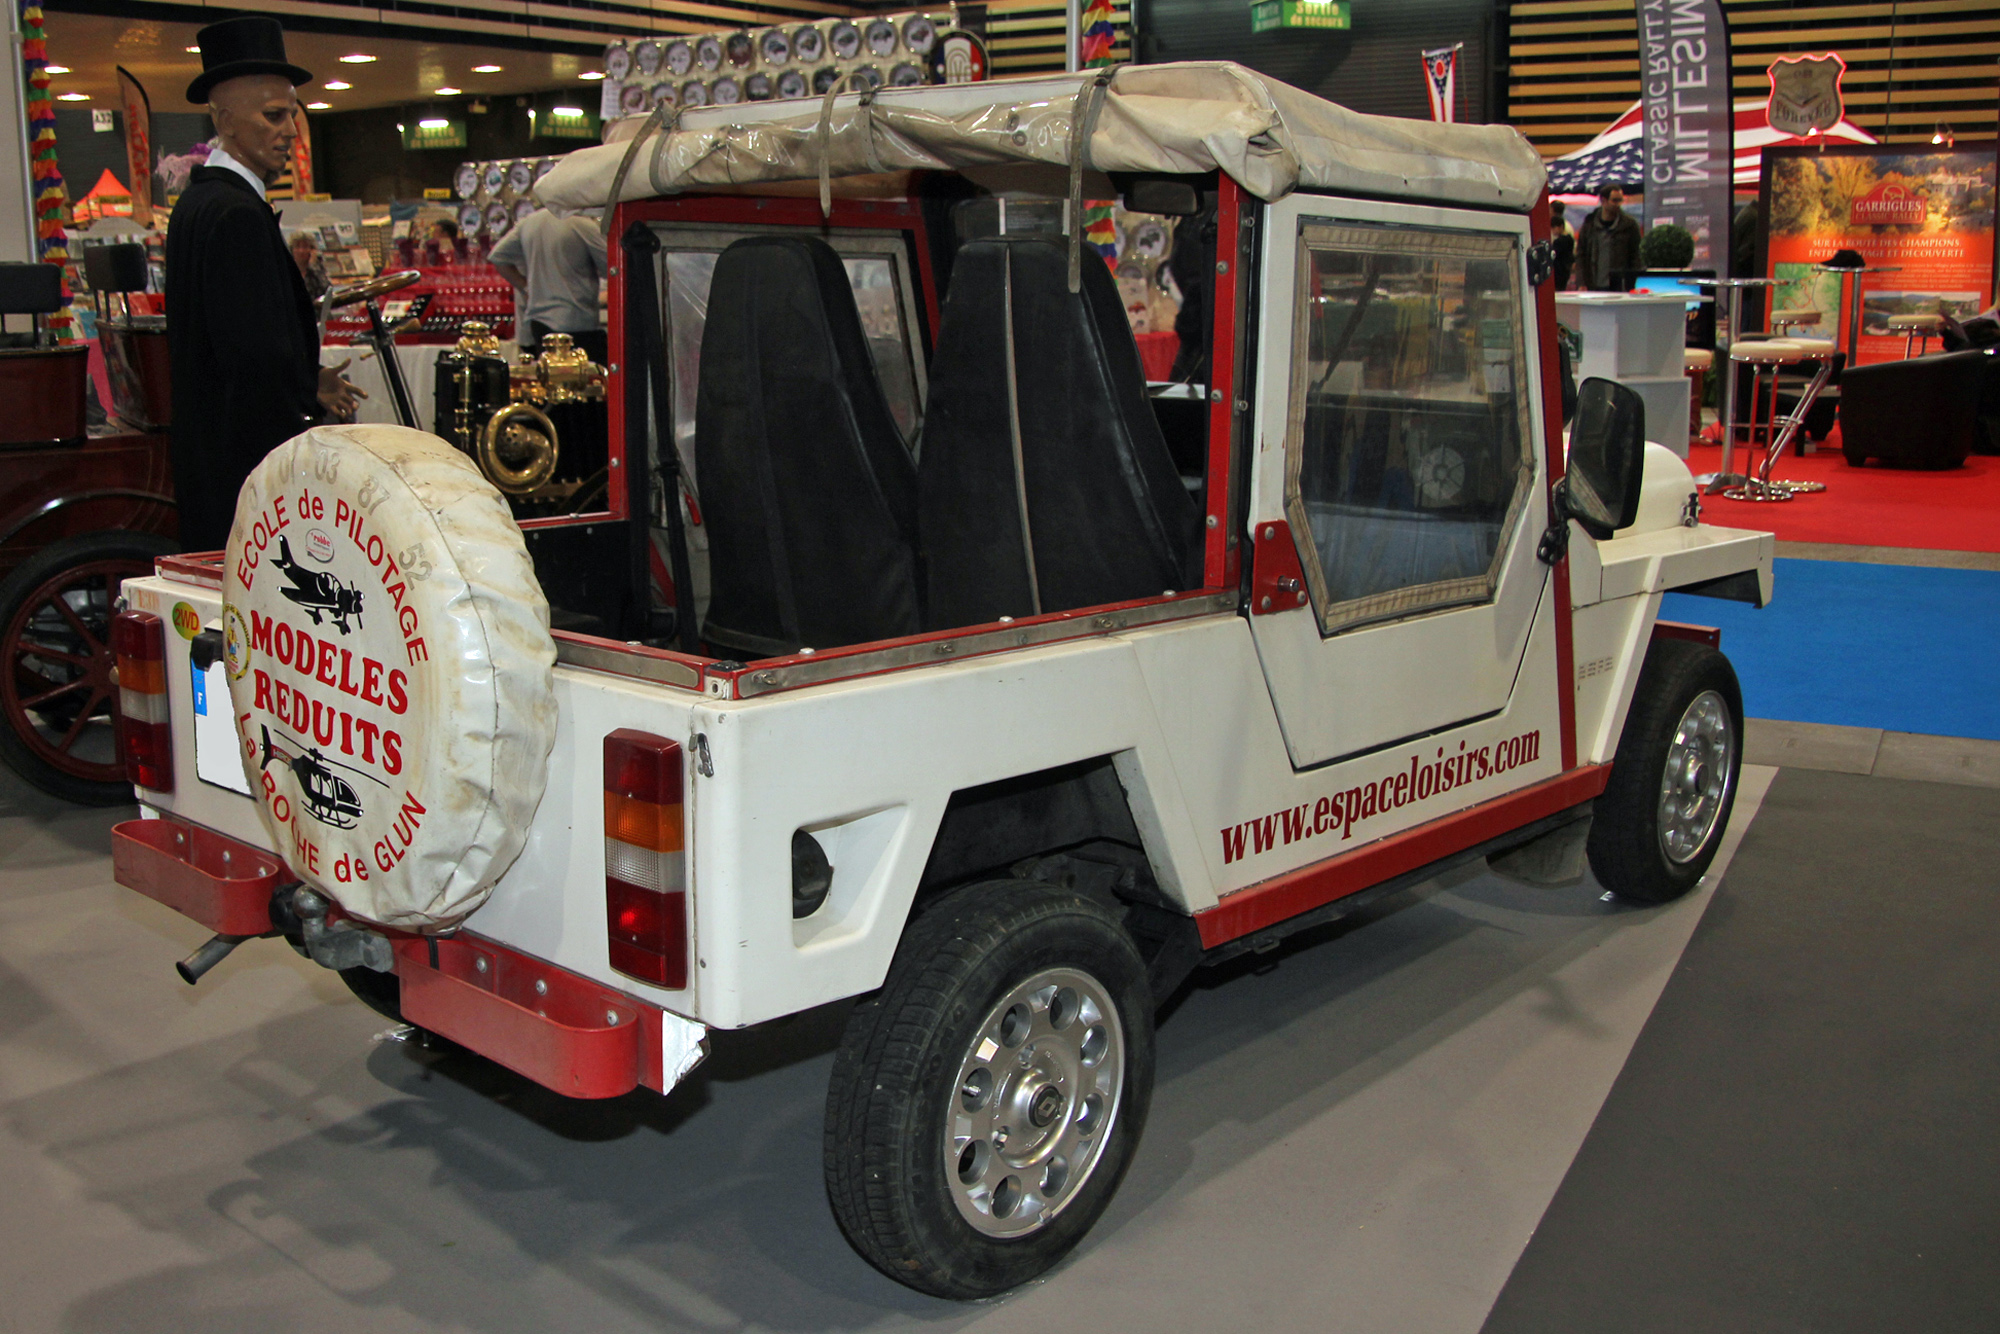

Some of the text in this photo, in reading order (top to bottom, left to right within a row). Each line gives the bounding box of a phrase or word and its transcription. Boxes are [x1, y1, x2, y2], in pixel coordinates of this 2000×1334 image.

[1855, 201, 1921, 212] GARRIGUES
[237, 495, 291, 592] ECOLE
[298, 488, 324, 520] de
[335, 498, 429, 666] PILOTAGE
[399, 543, 432, 591] 52
[174, 608, 200, 631] 2WD
[250, 609, 408, 715] MODELES
[198, 692, 203, 705] F
[254, 668, 403, 776] REDUITS
[334, 853, 369, 883] de
[374, 790, 427, 873] GLUN
[1220, 729, 1541, 865] www.espaceloisirs.com
